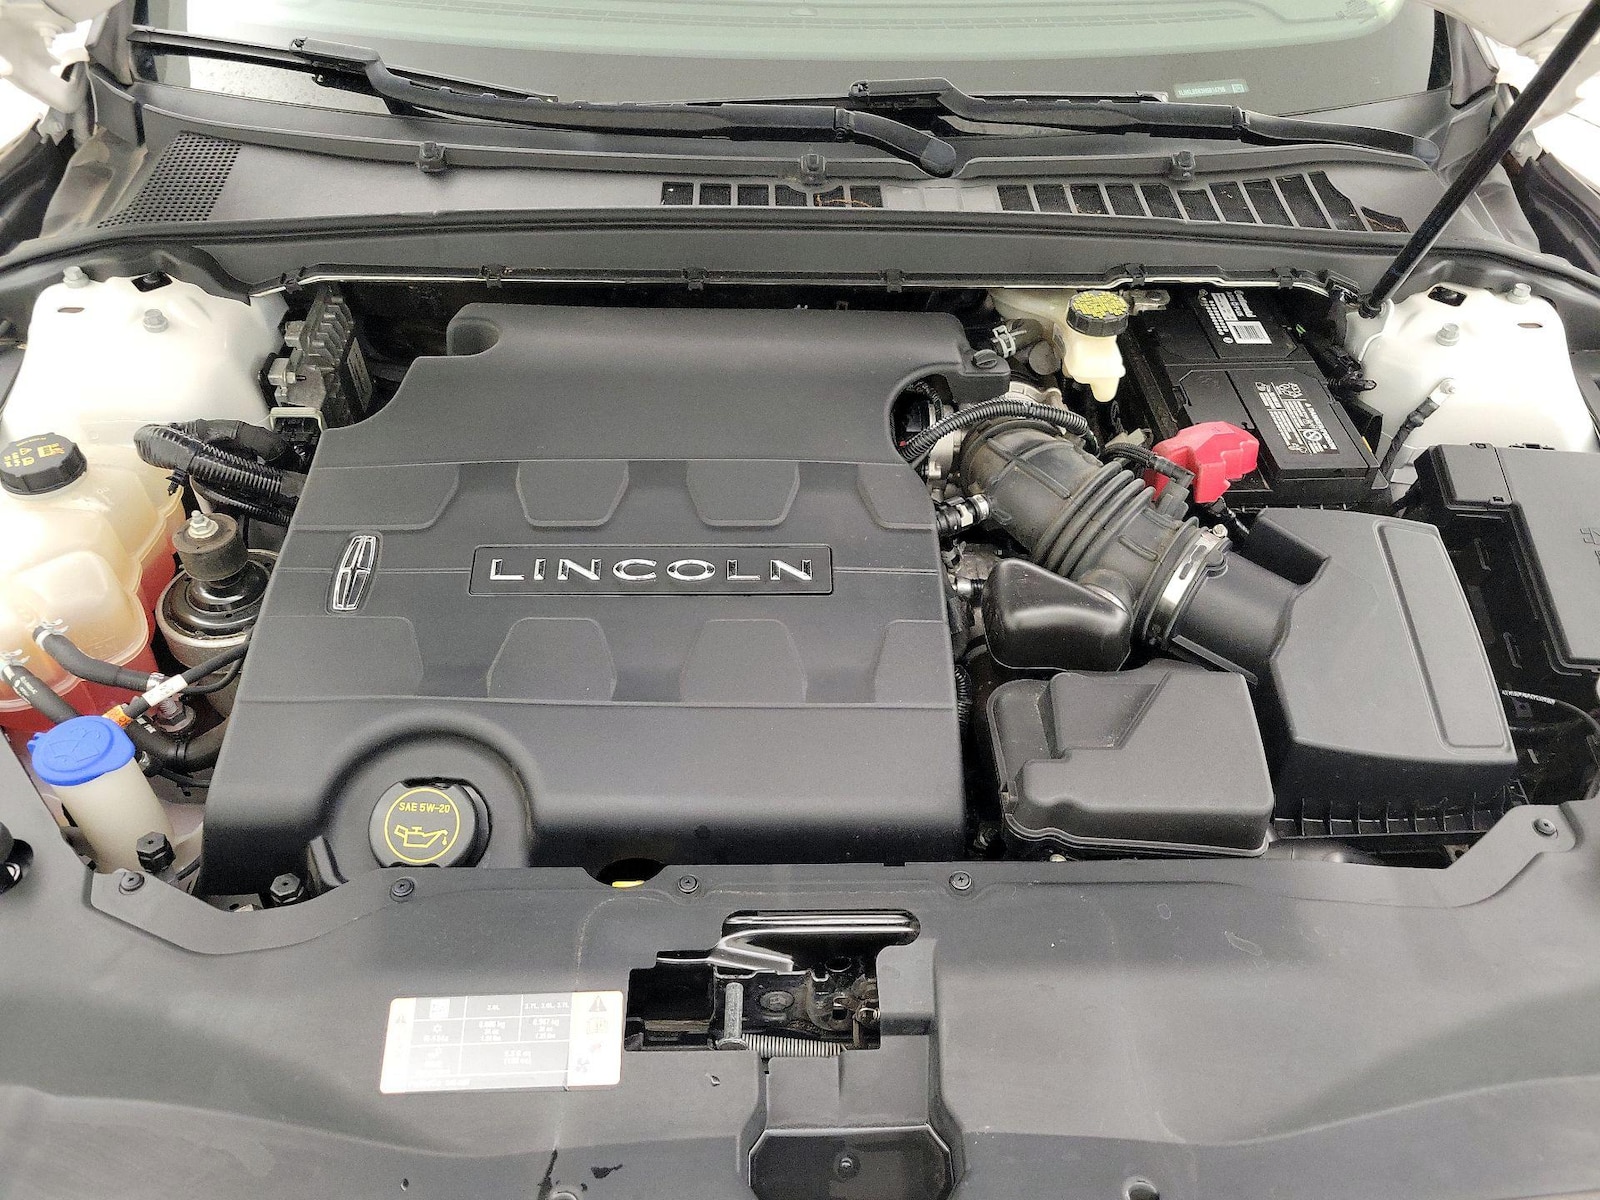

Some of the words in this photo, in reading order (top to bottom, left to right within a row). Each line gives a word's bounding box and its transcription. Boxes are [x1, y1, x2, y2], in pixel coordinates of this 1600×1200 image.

[489, 558, 813, 581] LINCOLN
[398, 802, 418, 812] SAE
[419, 802, 450, 813] 5W-20
